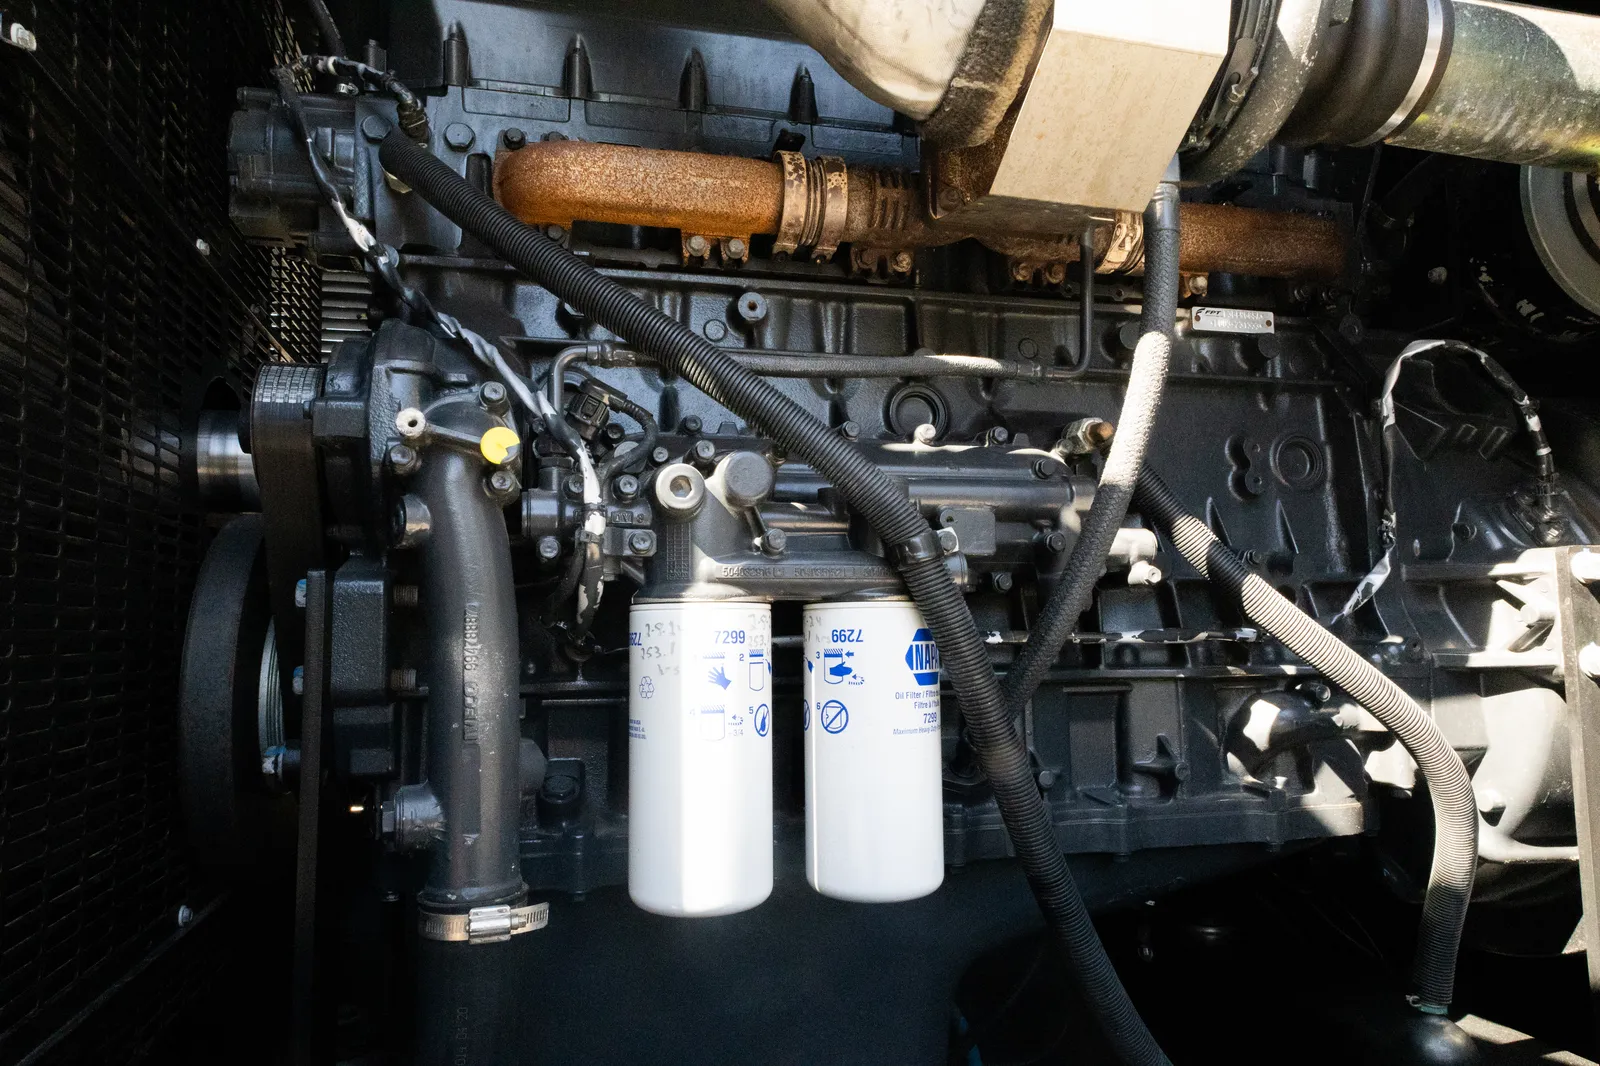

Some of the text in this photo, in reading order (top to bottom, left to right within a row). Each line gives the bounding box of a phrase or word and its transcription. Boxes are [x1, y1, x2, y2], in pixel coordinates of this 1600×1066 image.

[714, 630, 746, 644] 7299
[831, 629, 863, 643] 7299
[739, 653, 745, 661] 2
[816, 651, 821, 659] 3
[895, 691, 904, 700] Oil
[906, 691, 921, 699] Filter
[749, 706, 754, 715] 5
[816, 702, 821, 710] 6
[923, 712, 937, 723] 7299
